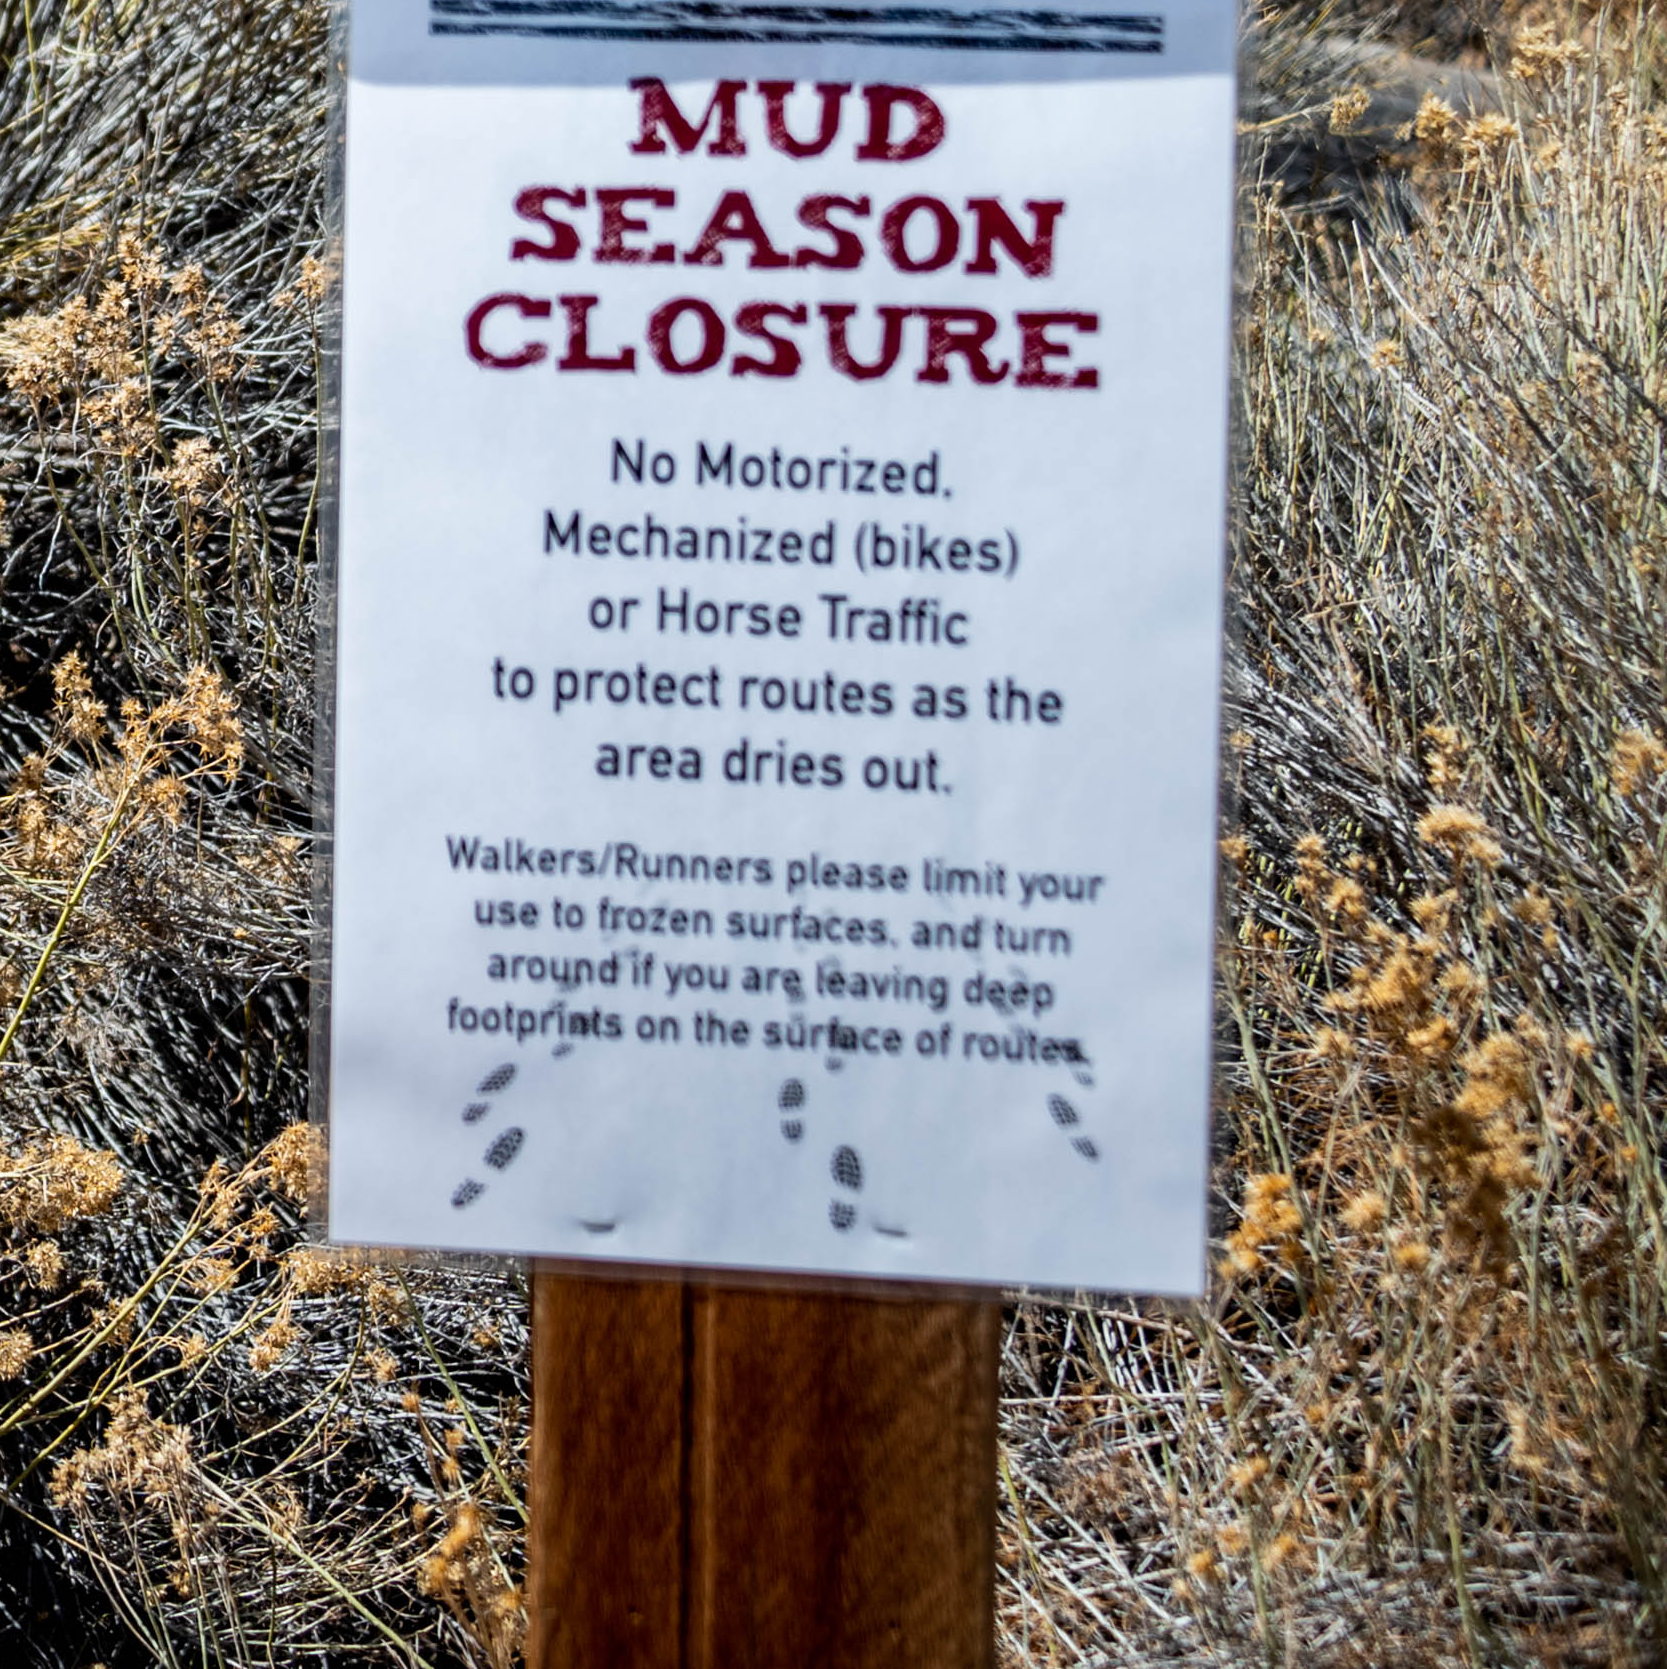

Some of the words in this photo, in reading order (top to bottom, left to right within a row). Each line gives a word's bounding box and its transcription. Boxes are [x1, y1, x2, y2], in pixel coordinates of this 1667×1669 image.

[626, 74, 947, 164] MUD
[510, 186, 1066, 279] SEASON
[464, 292, 1100, 390] CLOSURE
[612, 438, 676, 485] No
[544, 509, 836, 566] Mechanized
[854, 522, 1019, 575] (bikes)
[588, 596, 640, 631] or
[657, 587, 803, 638] Horse
[818, 593, 968, 646] Traffic
[493, 657, 535, 700] to
[553, 663, 721, 714] protect
[739, 671, 895, 716] routes
[912, 684, 969, 720] as
[987, 677, 1064, 724] the
[595, 743, 703, 781] area
[722, 738, 845, 788] dries
[863, 750, 951, 794] out.
[446, 836, 774, 886] Walkers/Runners
[786, 853, 910, 894] please
[923, 858, 1007, 897] limit
[1018, 873, 1105, 908] your
[474, 900, 540, 929] use
[552, 897, 586, 931] to
[598, 896, 714, 936] frozen
[911, 916, 984, 951] and
[992, 919, 1072, 956] turn
[487, 951, 621, 986] around
[627, 950, 655, 987] if
[664, 963, 730, 998] you
[741, 965, 805, 995] are
[816, 964, 950, 1013] leaving
[963, 971, 1055, 1012] deep
[448, 997, 624, 1047] footprints
[635, 1014, 681, 1042] on
[693, 1010, 751, 1046] the
[763, 1016, 903, 1054] surface
[915, 1022, 953, 1057] of
